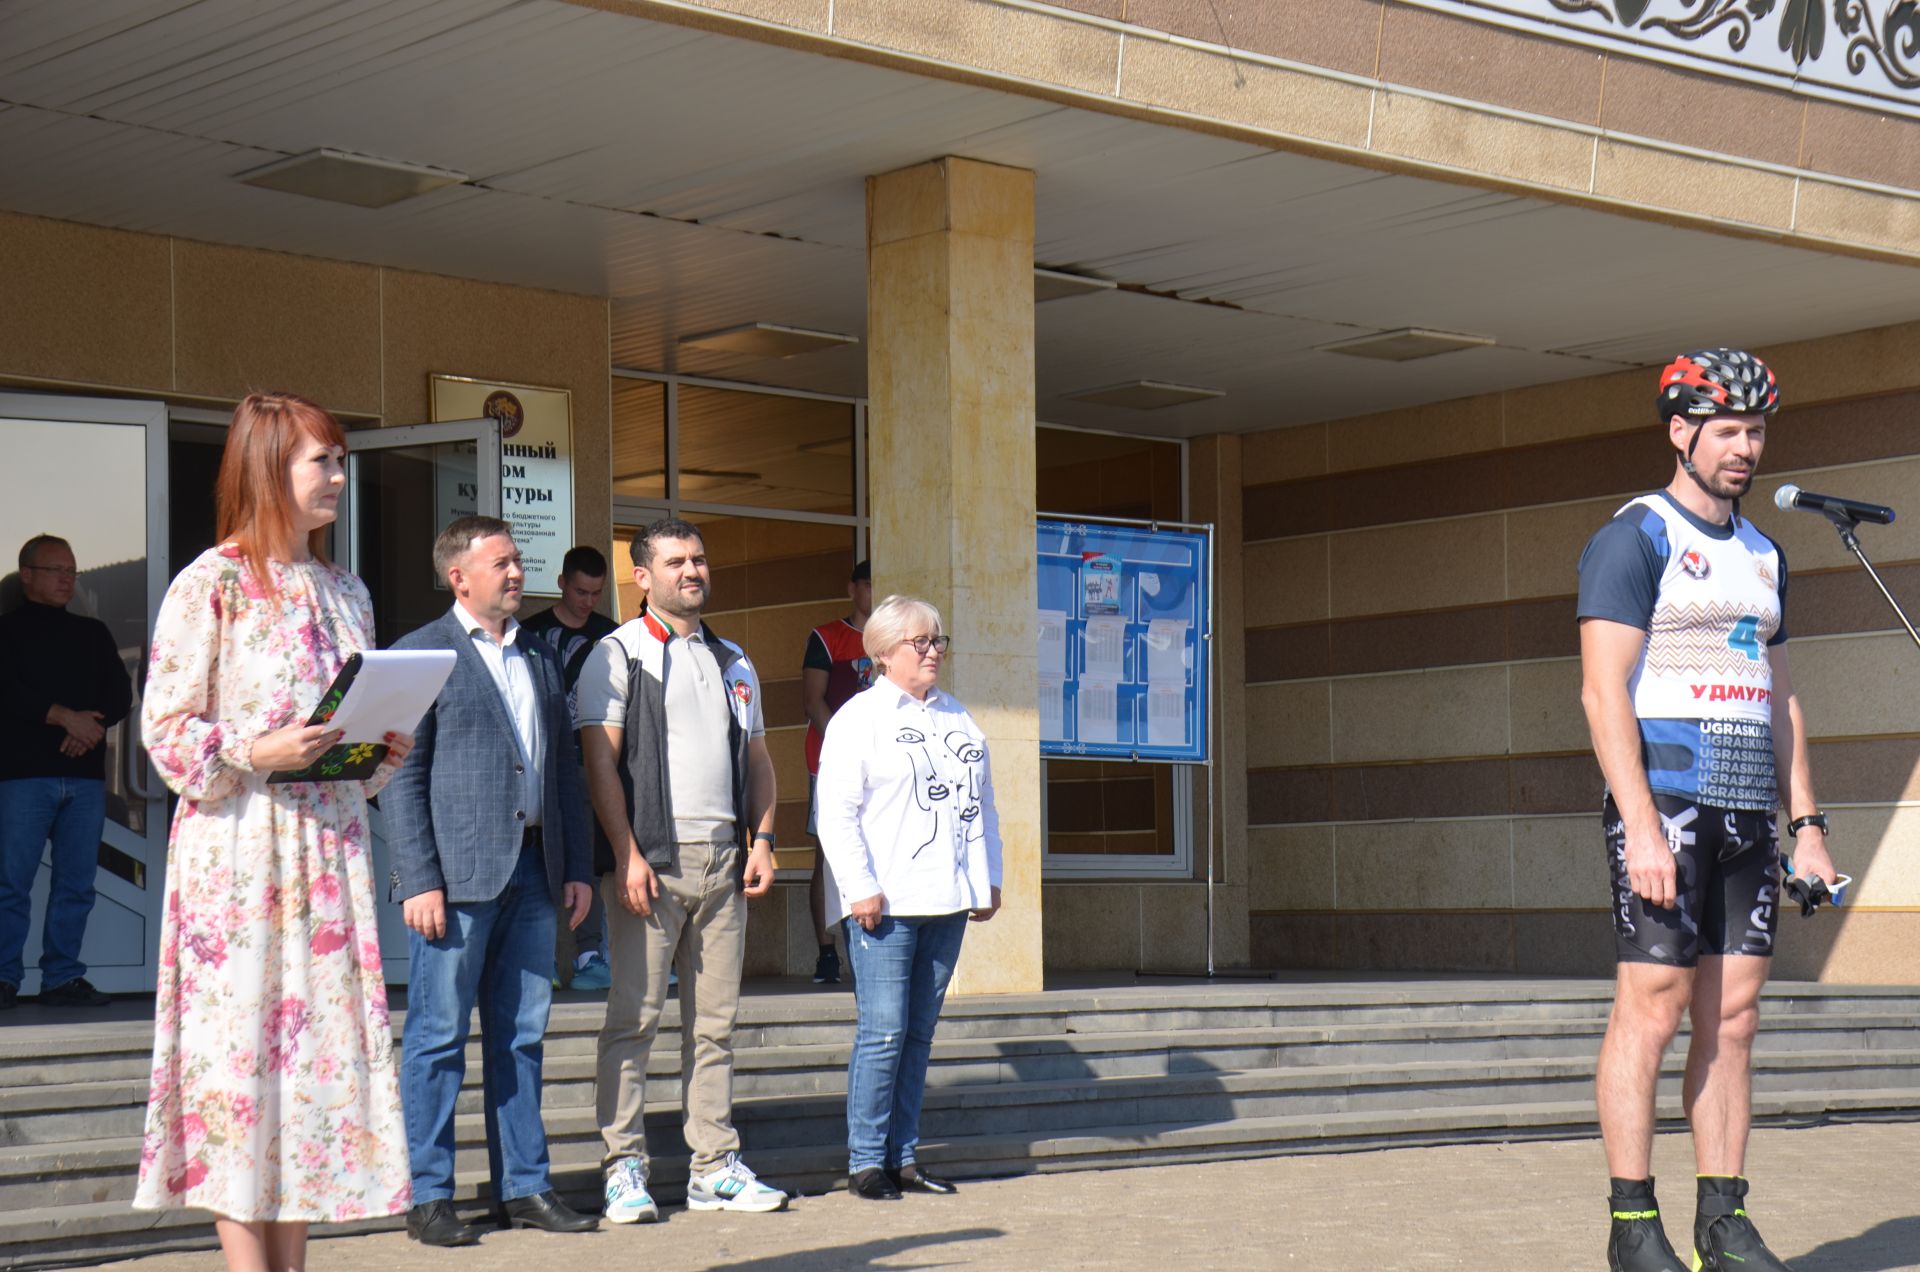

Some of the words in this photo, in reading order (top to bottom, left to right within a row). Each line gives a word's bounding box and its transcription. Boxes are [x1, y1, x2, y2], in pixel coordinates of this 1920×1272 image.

[502, 464, 526, 479] ом
[458, 483, 553, 504] кутуры
[512, 521, 541, 529] ультуры
[1728, 615, 1760, 661] 4
[1690, 685, 1772, 704] УДМУРТ
